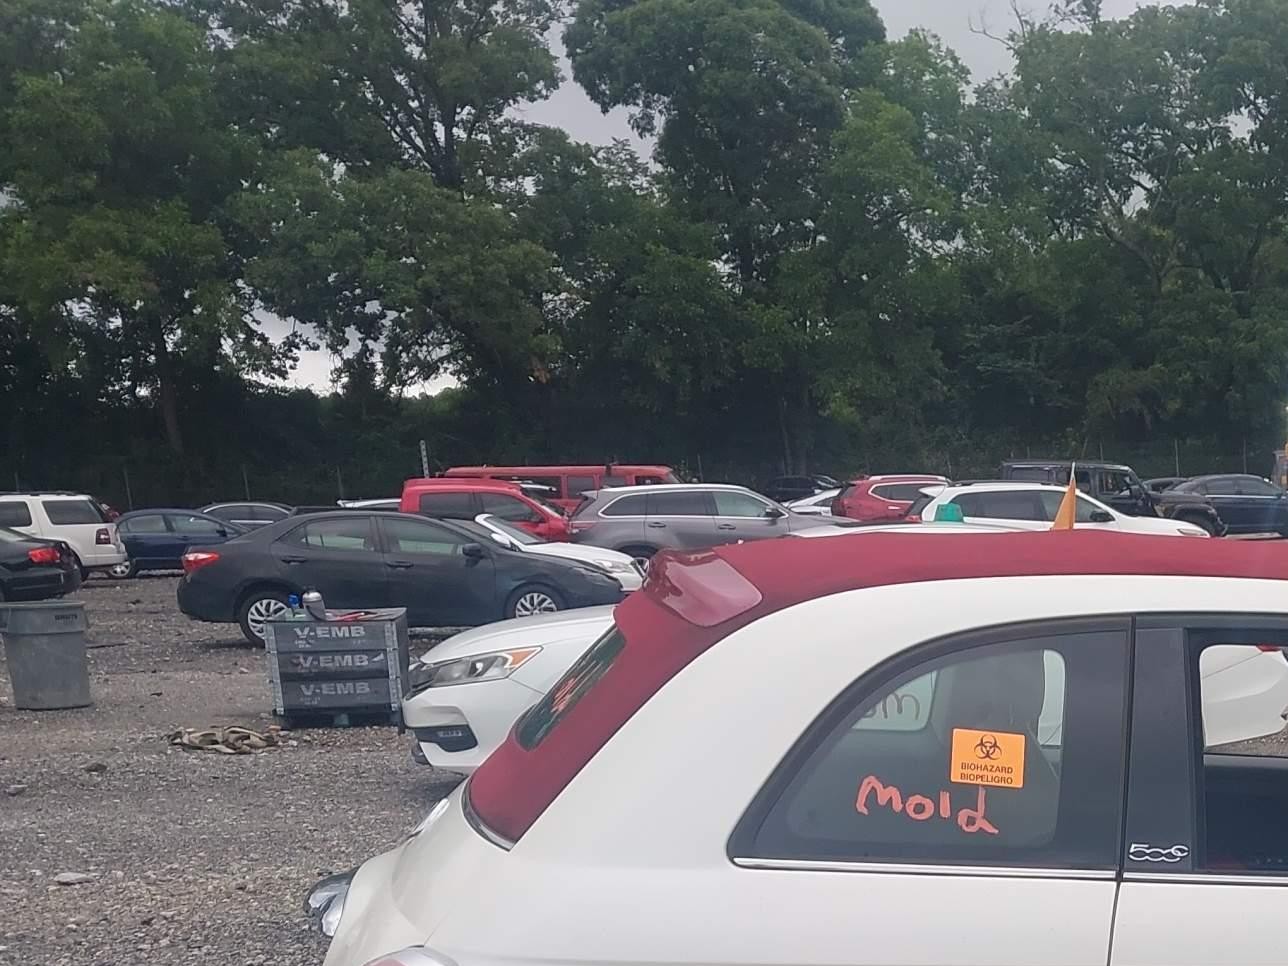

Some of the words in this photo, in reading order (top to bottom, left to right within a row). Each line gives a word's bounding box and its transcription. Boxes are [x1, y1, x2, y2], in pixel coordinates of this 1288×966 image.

[294, 625, 366, 638] V-EMB
[300, 682, 370, 695] V-EMB
[960, 762, 1013, 775] BIOHAZARD
[959, 772, 1013, 785] BIOPELIGRO
